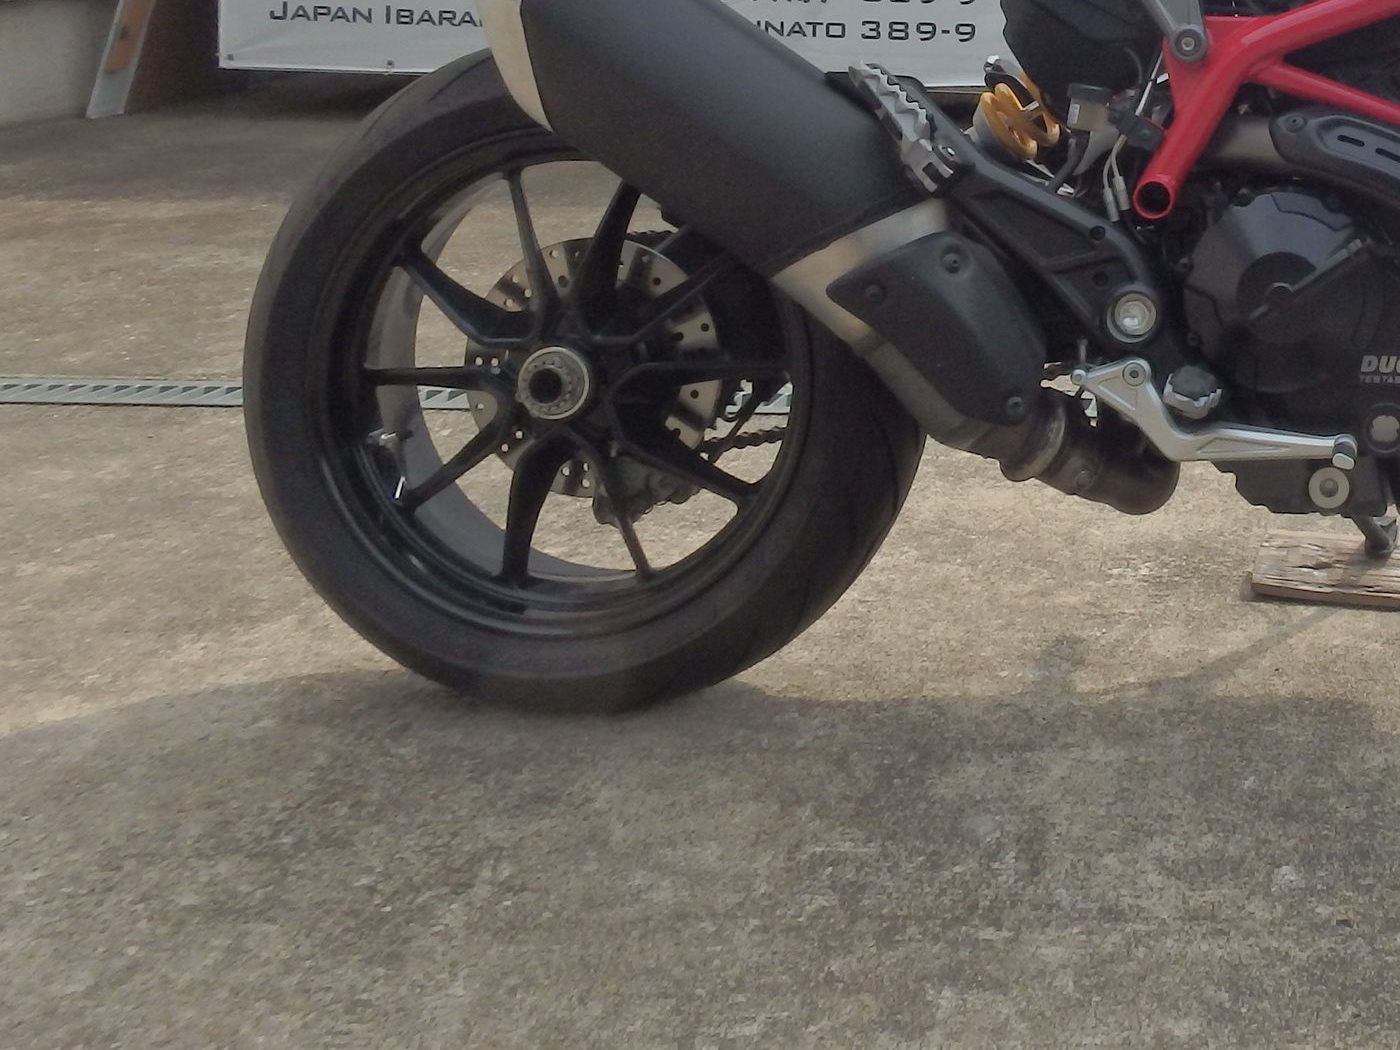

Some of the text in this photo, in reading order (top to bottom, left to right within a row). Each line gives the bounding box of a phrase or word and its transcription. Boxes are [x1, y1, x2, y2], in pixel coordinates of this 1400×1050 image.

[269, 1, 483, 28] JAPAN IBARA
[861, 20, 976, 43] 389-9
